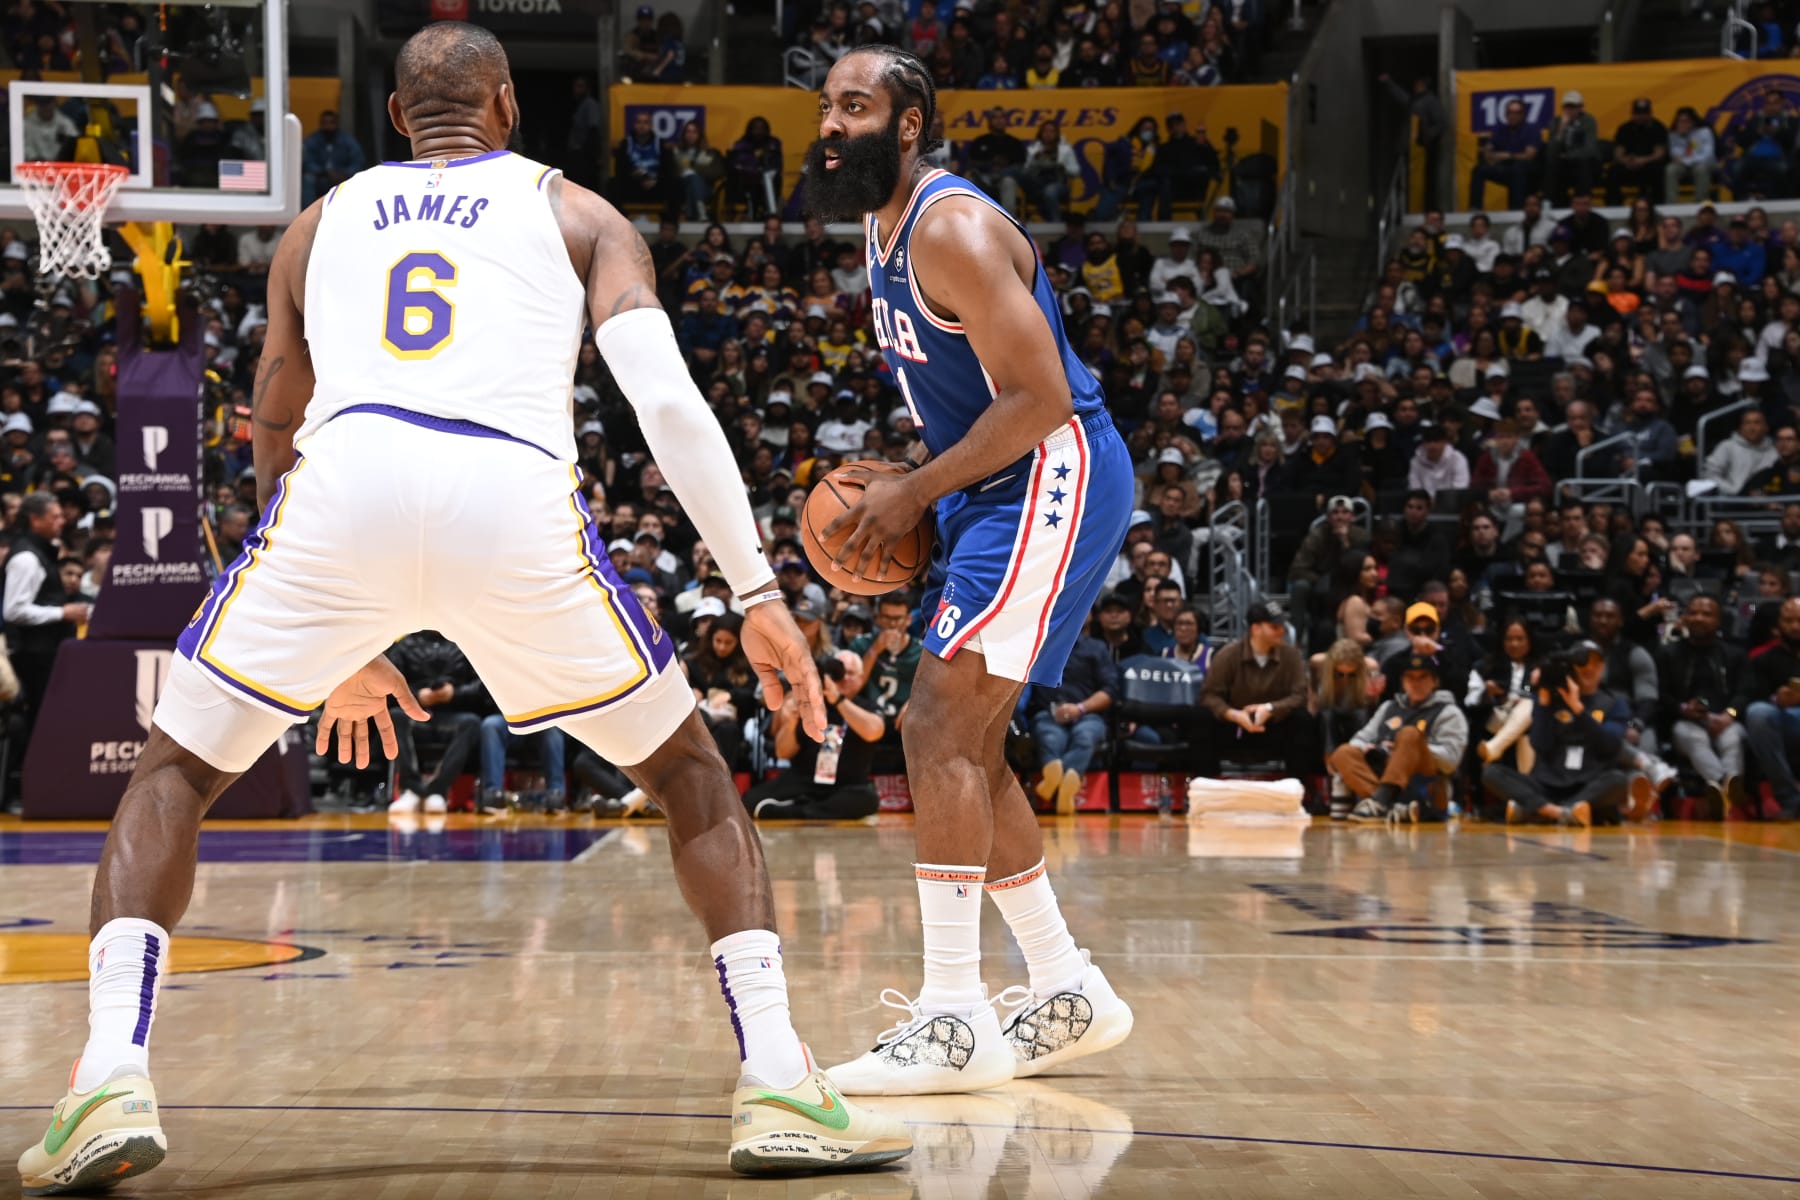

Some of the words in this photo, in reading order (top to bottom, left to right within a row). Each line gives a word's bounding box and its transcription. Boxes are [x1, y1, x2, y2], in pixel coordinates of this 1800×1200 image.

[478, 0, 562, 13] TOYOTA
[373, 194, 489, 231] JAMES
[380, 250, 459, 360] 6
[871, 297, 929, 363] HILA
[896, 366, 925, 428] 1
[119, 473, 191, 486] PECHANGA
[112, 562, 200, 578] PECHANGA
[1140, 668, 1192, 684] DELTA
[91, 741, 147, 761] PECH
[90, 760, 136, 774] RESO
